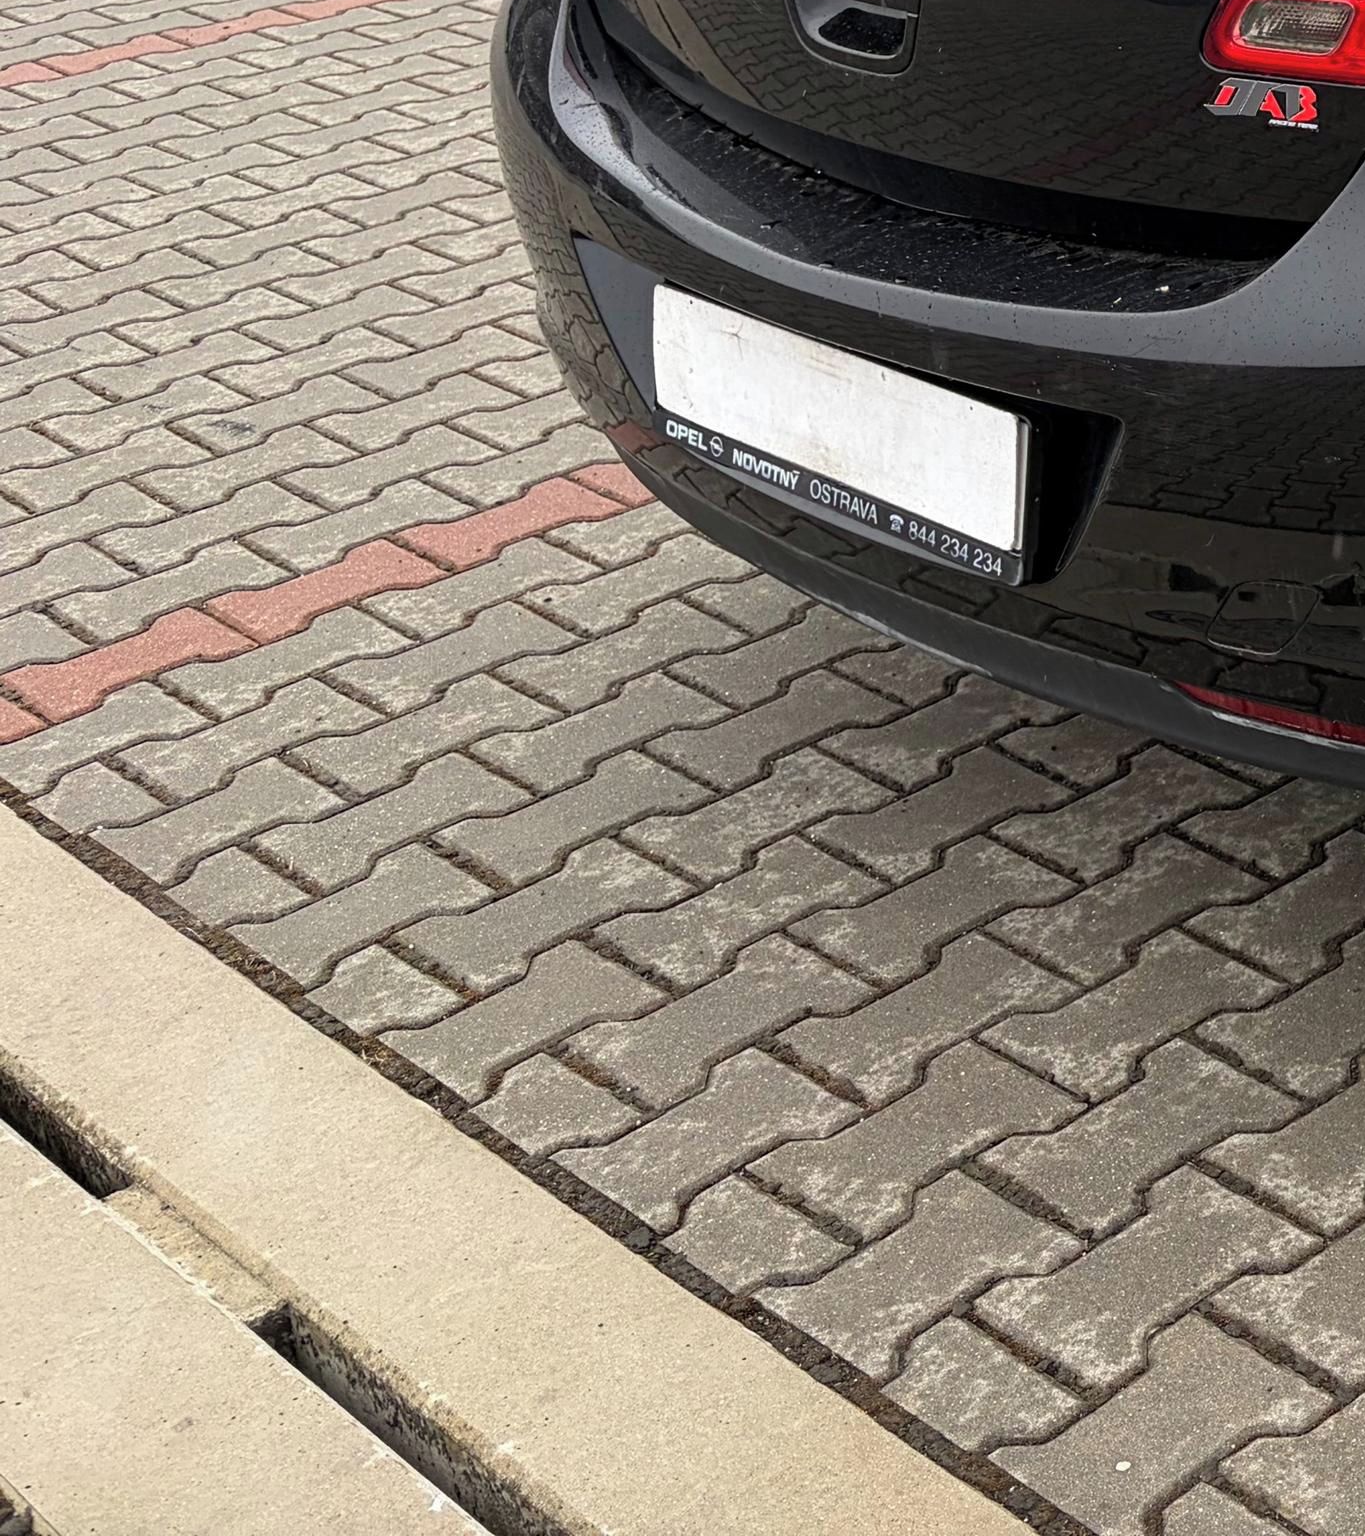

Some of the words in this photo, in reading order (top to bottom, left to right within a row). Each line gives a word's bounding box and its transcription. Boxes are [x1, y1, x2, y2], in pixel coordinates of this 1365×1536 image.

[665, 419, 708, 452] OPEL
[732, 447, 801, 491] NOVOTNÝ
[808, 478, 879, 525] OSTRAVA
[908, 520, 937, 547] 844
[940, 533, 970, 563] 234
[973, 548, 1004, 577] 234
